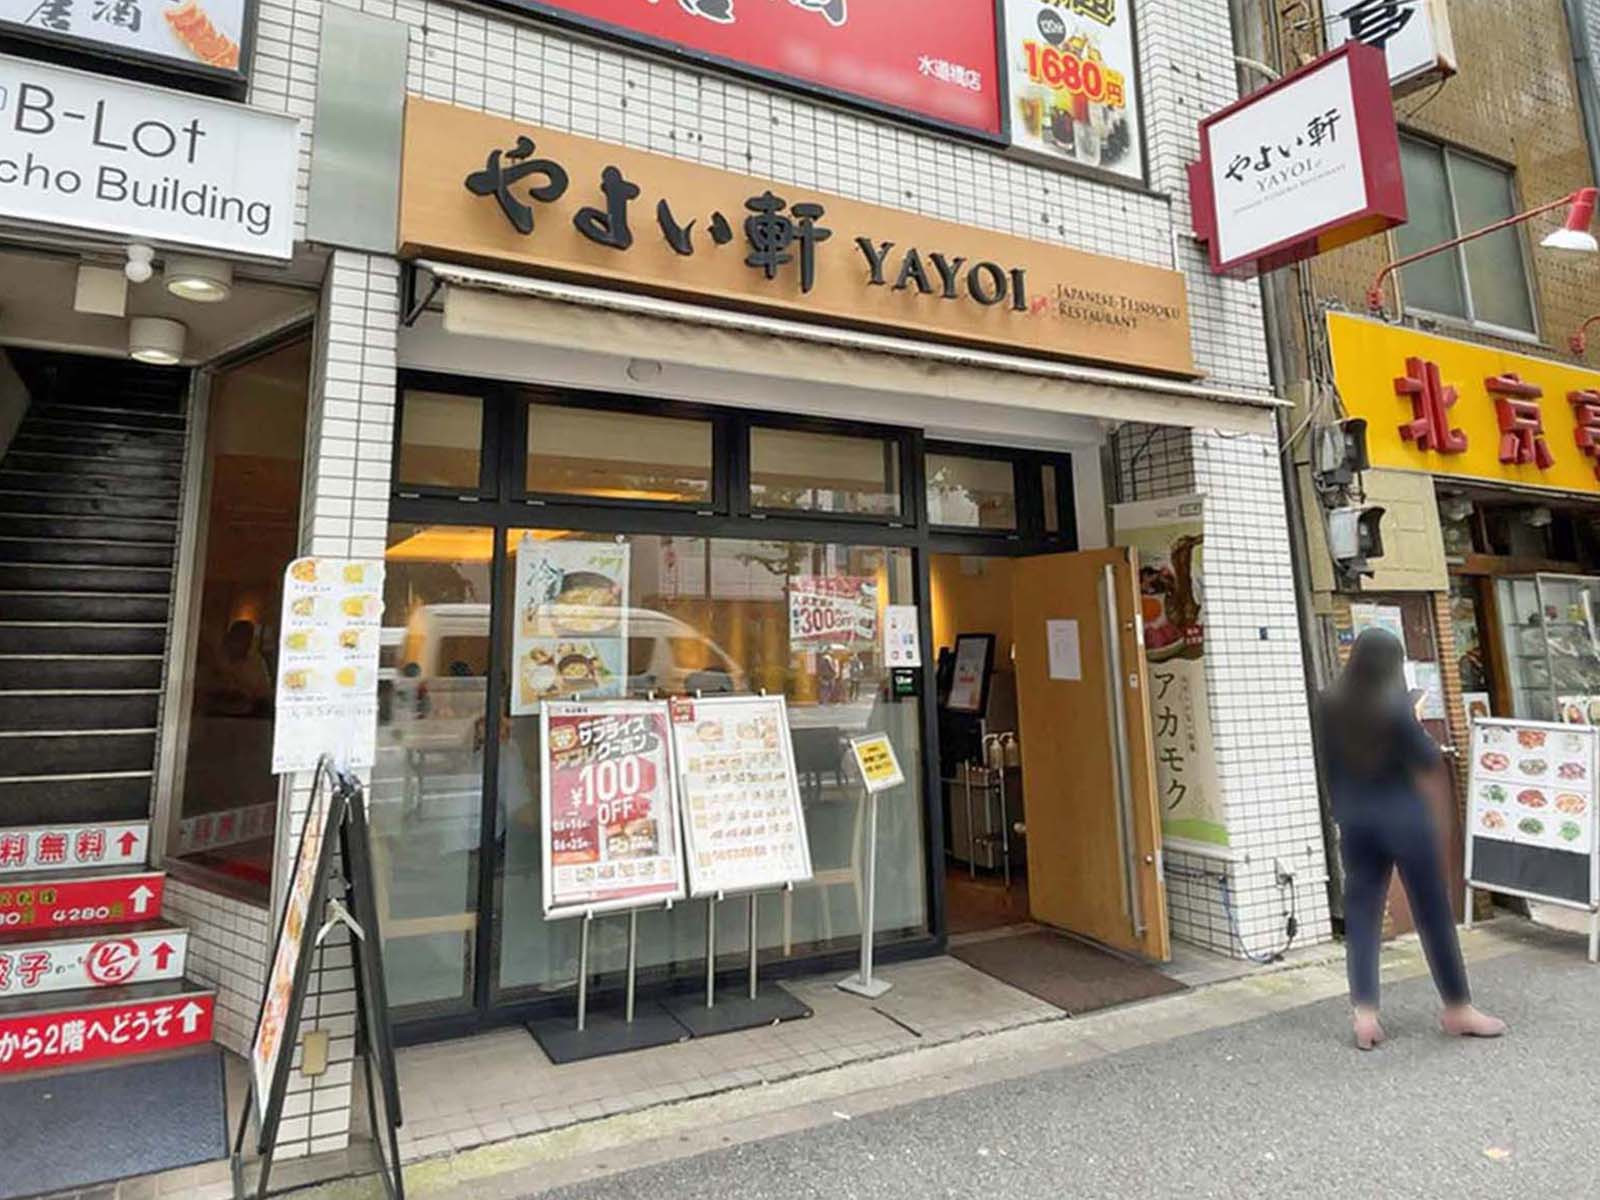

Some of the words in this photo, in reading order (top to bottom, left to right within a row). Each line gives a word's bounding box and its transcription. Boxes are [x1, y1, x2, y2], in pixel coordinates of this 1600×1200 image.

[1023, 41, 1123, 106] 1680円
[15, 83, 206, 163] B-Lot
[1225, 108, 1341, 181] やよい軒
[96, 166, 272, 236] Building
[1257, 158, 1312, 191] YAYOI
[465, 135, 832, 295] やよい軒
[855, 235, 1029, 313] YAYOI
[1154, 672, 1187, 811] アカモク
[597, 798, 634, 826] OFF
[0, 1006, 173, 1062] から2階へどうぞ
